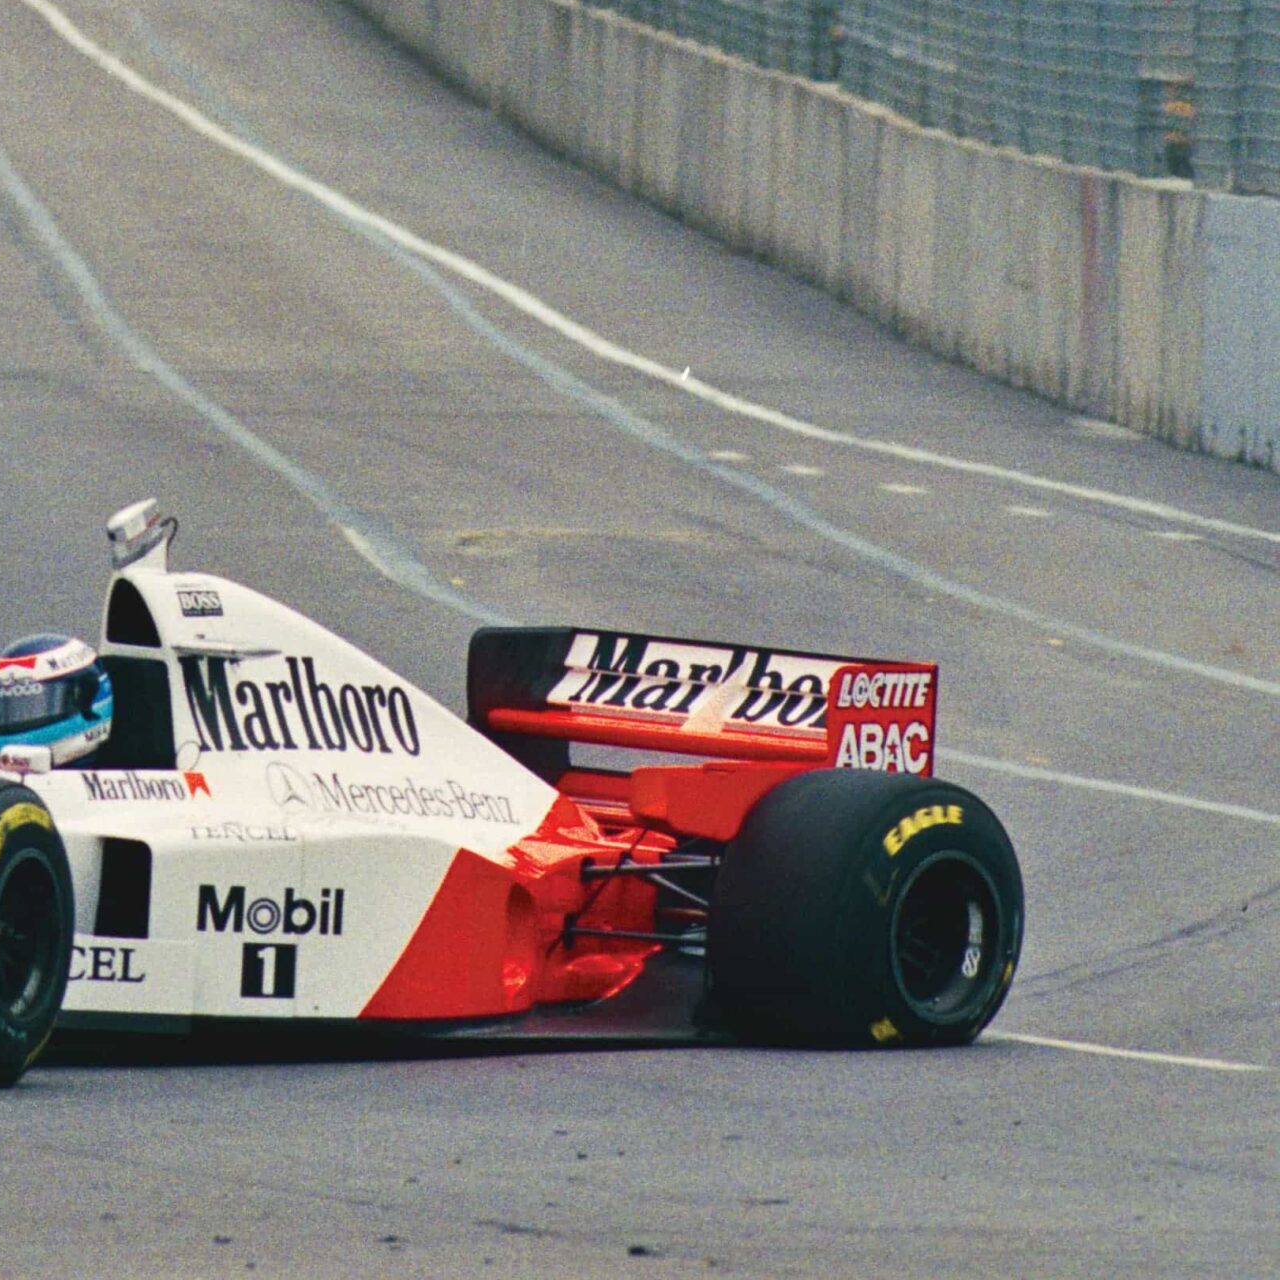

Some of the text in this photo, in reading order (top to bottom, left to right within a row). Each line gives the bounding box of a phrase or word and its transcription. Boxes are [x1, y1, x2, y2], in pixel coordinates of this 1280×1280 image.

[178, 591, 221, 610] BOSS
[177, 655, 421, 757] Marlboro
[837, 671, 933, 710] LOCTITE
[835, 721, 931, 775] ABAC
[81, 771, 186, 801] Marlboro
[311, 772, 521, 824] Mercedes-Benz
[882, 804, 964, 857] EAGLE
[196, 884, 345, 936] Mobil
[257, 945, 277, 996] 1
